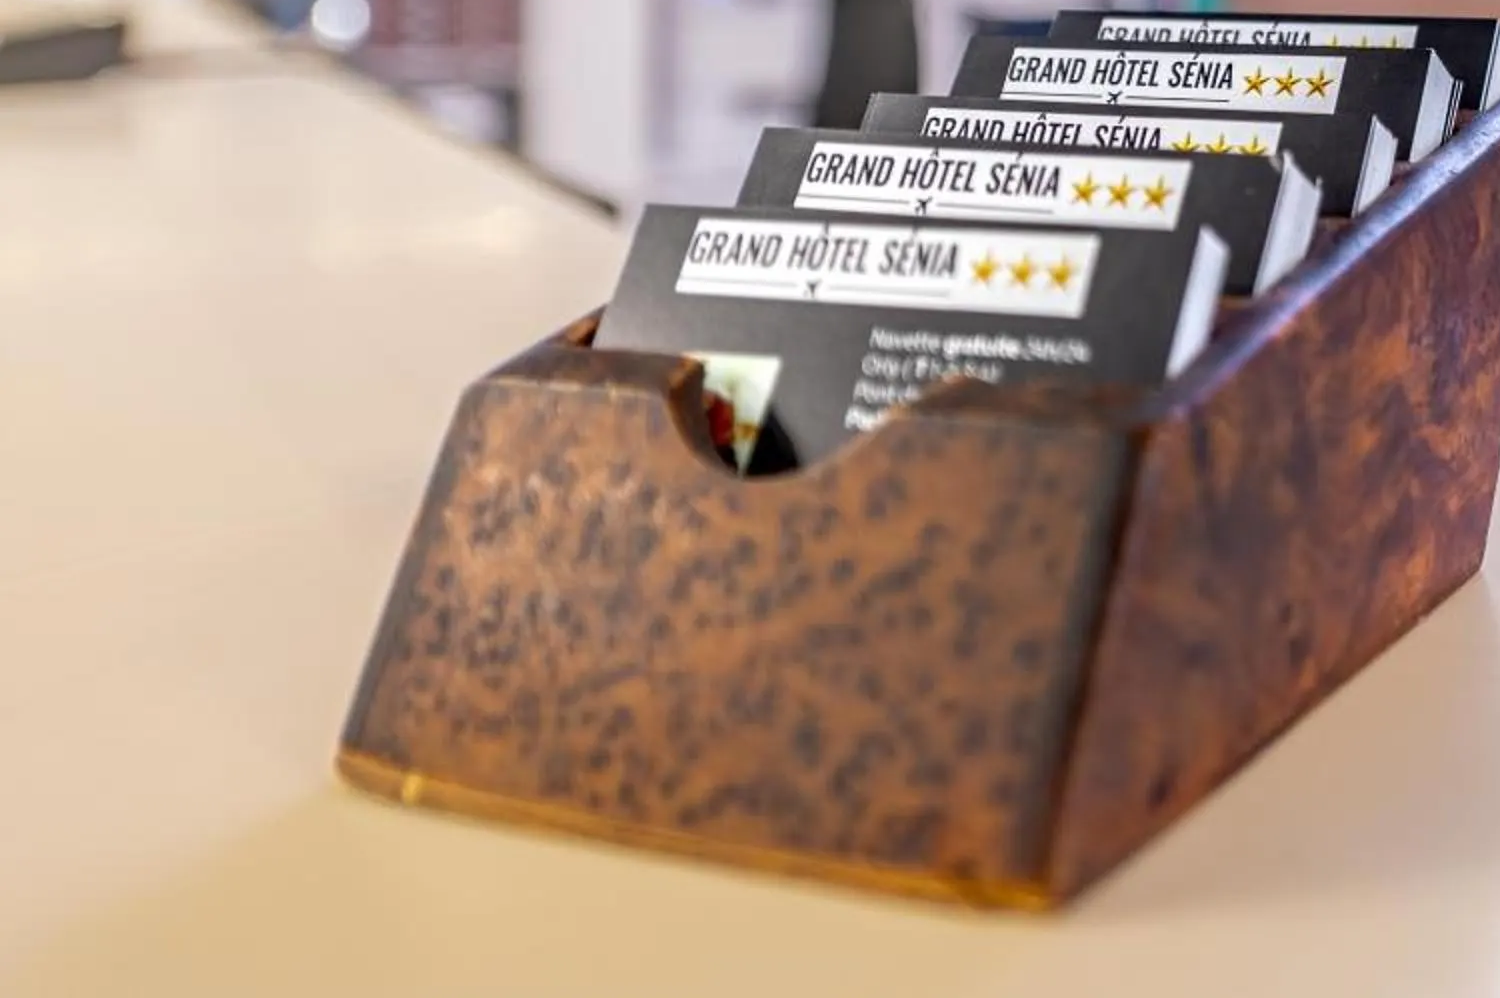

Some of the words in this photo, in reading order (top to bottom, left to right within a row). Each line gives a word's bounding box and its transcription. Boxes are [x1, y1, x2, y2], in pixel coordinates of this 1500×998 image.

[1008, 56, 1087, 84] GRAND
[1091, 51, 1160, 87] HÔTEL
[1168, 51, 1234, 90] SÉNIA
[924, 116, 1005, 141] GRAND
[1012, 112, 1081, 146] HÔTEL
[1094, 114, 1162, 151] SÉNIA
[805, 151, 895, 188] GRAND
[898, 147, 977, 193] HÔTEL
[985, 149, 1062, 198] SÉNIA
[688, 230, 784, 269] GRAND
[787, 221, 870, 274] HÔTEL
[877, 223, 961, 278] SÉNIA
